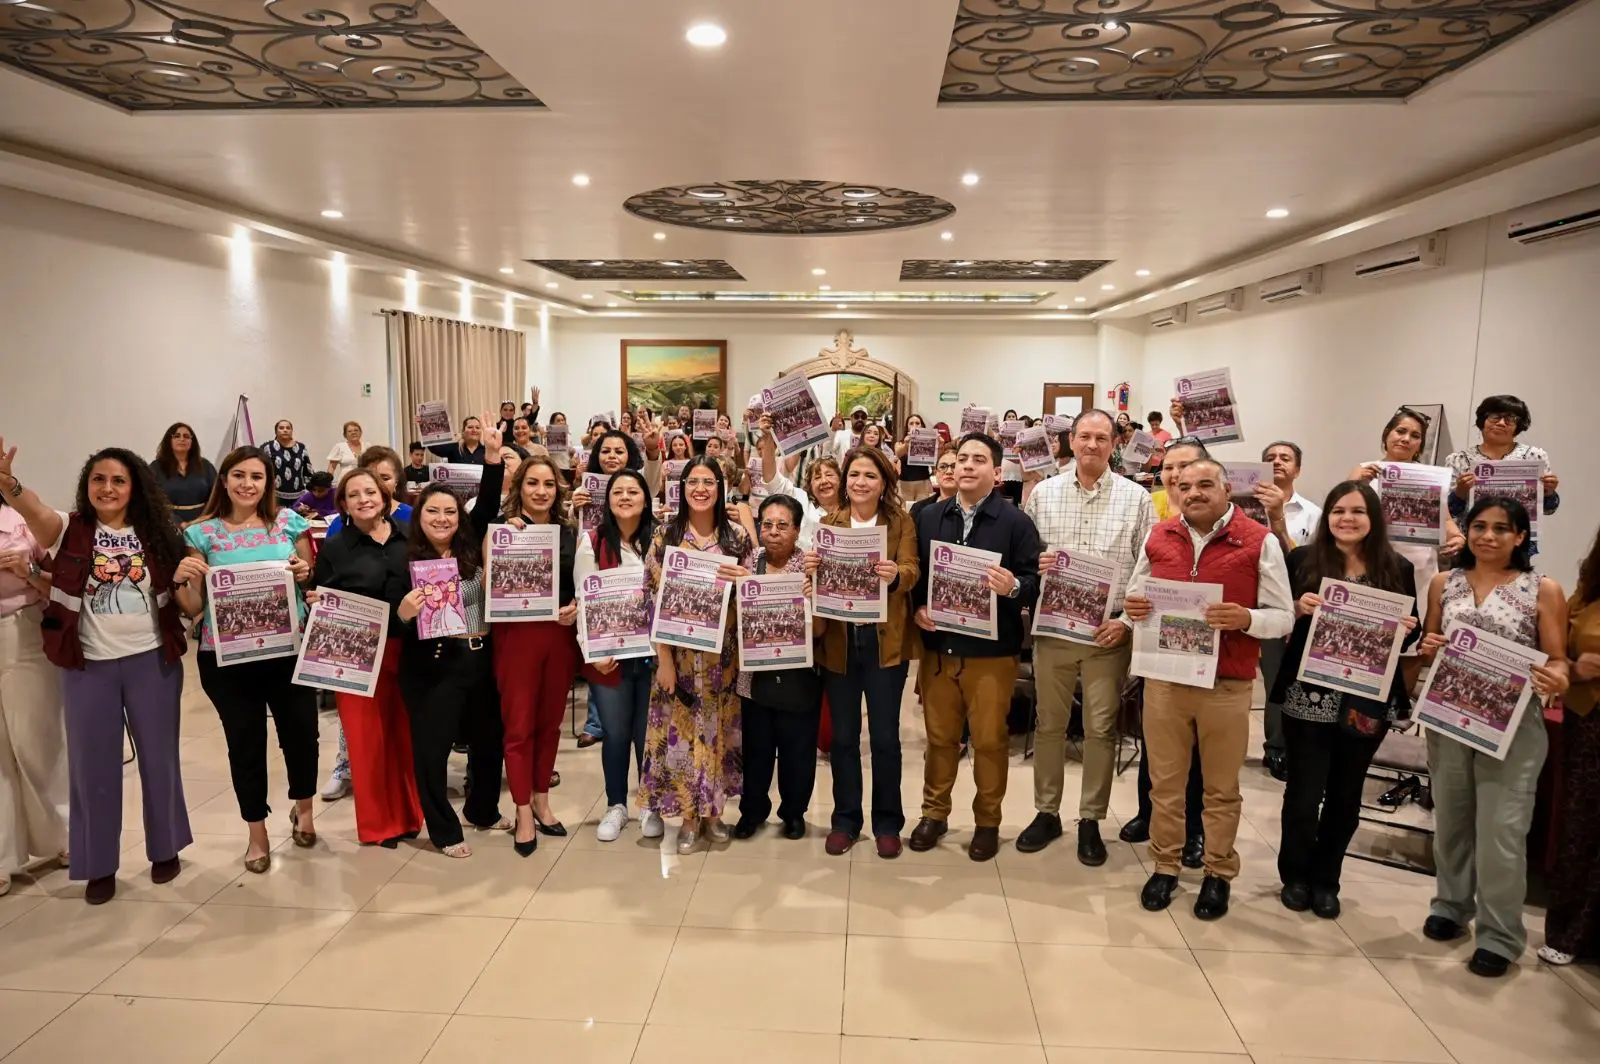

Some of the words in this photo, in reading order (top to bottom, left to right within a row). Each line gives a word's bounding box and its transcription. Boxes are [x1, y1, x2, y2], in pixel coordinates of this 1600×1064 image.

[1386, 466, 1400, 482] la
[1477, 463, 1492, 479] la
[586, 476, 598, 491] la
[495, 528, 511, 548] la
[820, 528, 833, 548] la
[671, 551, 686, 570] la
[938, 547, 950, 563] la
[216, 571, 231, 588] la
[586, 577, 600, 593] la
[744, 581, 759, 599] la
[1328, 585, 1345, 605] la
[320, 593, 338, 609] la
[1452, 628, 1473, 650] la
